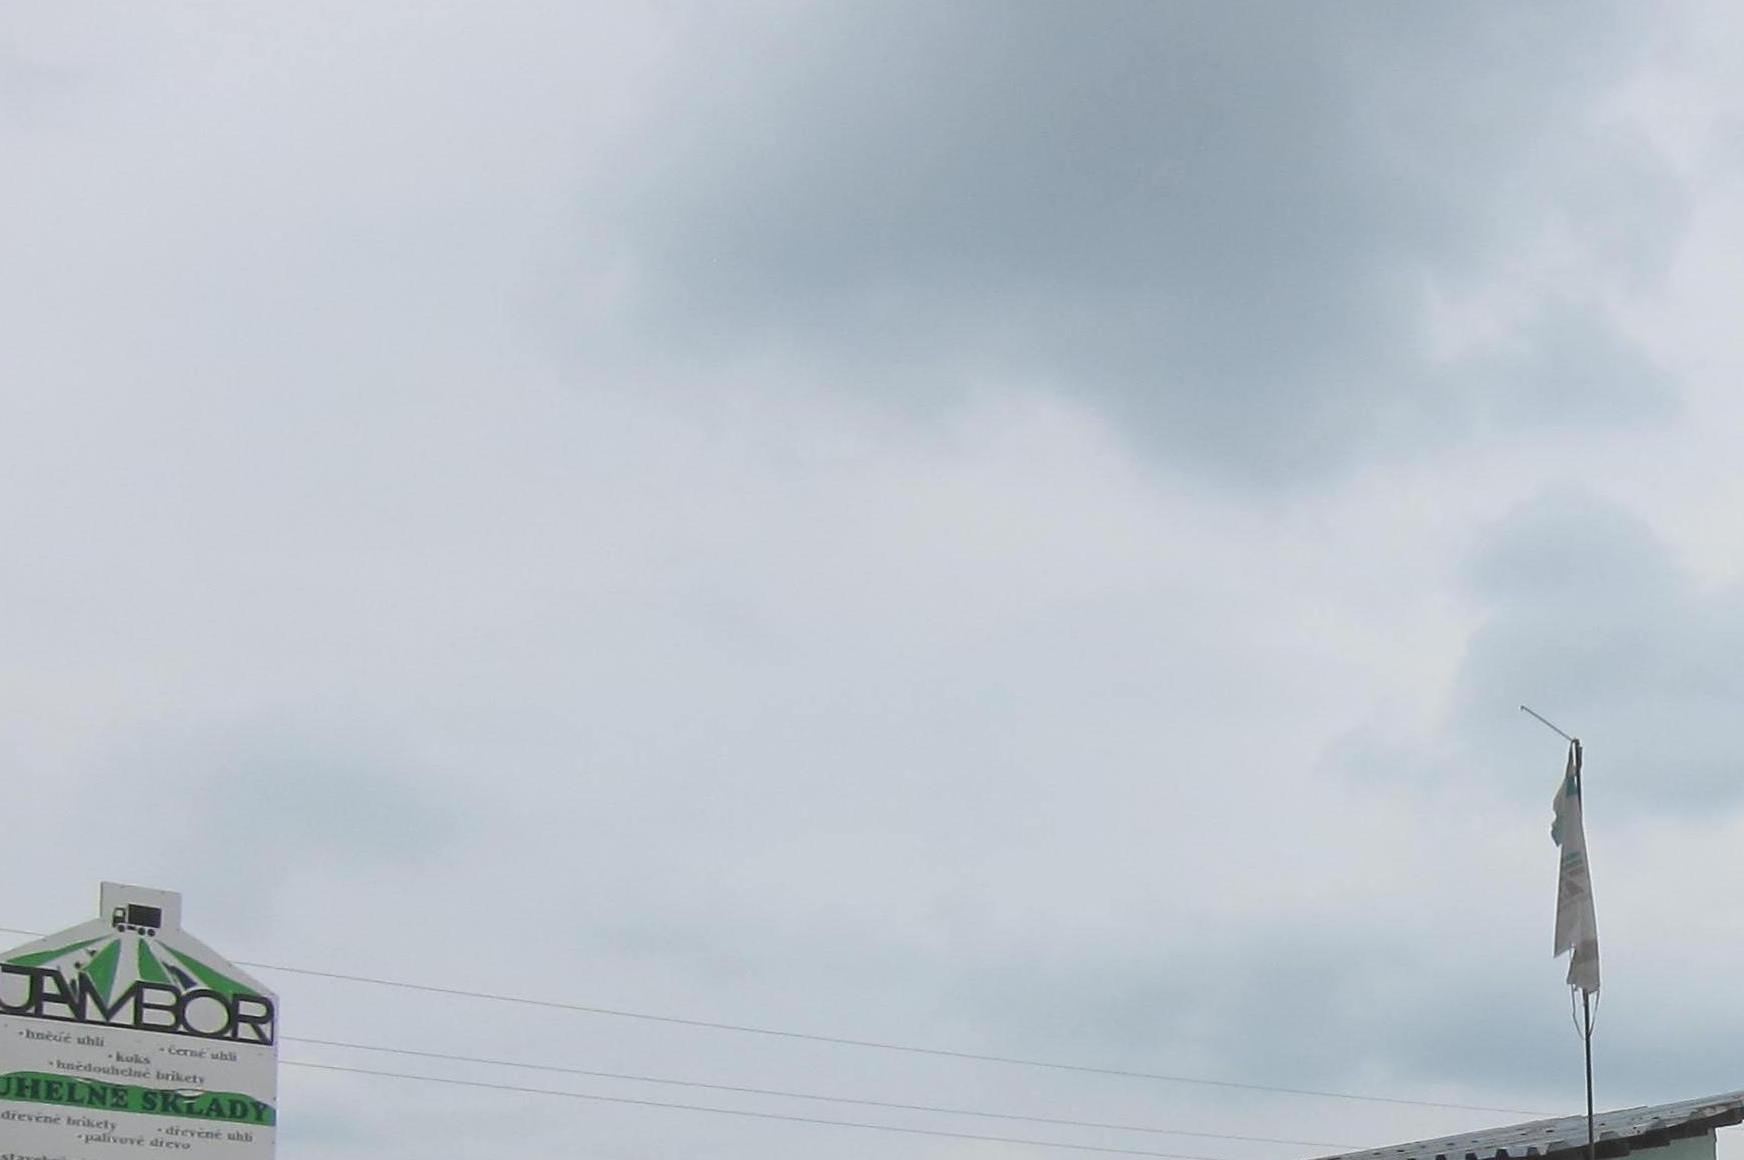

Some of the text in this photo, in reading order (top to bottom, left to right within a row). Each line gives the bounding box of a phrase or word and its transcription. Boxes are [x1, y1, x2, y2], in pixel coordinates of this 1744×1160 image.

[0, 963, 274, 1045] JAMBOR
[115, 1051, 151, 1064] koks
[155, 1070, 205, 1085] brikety
[66, 1115, 116, 1131] brikety
